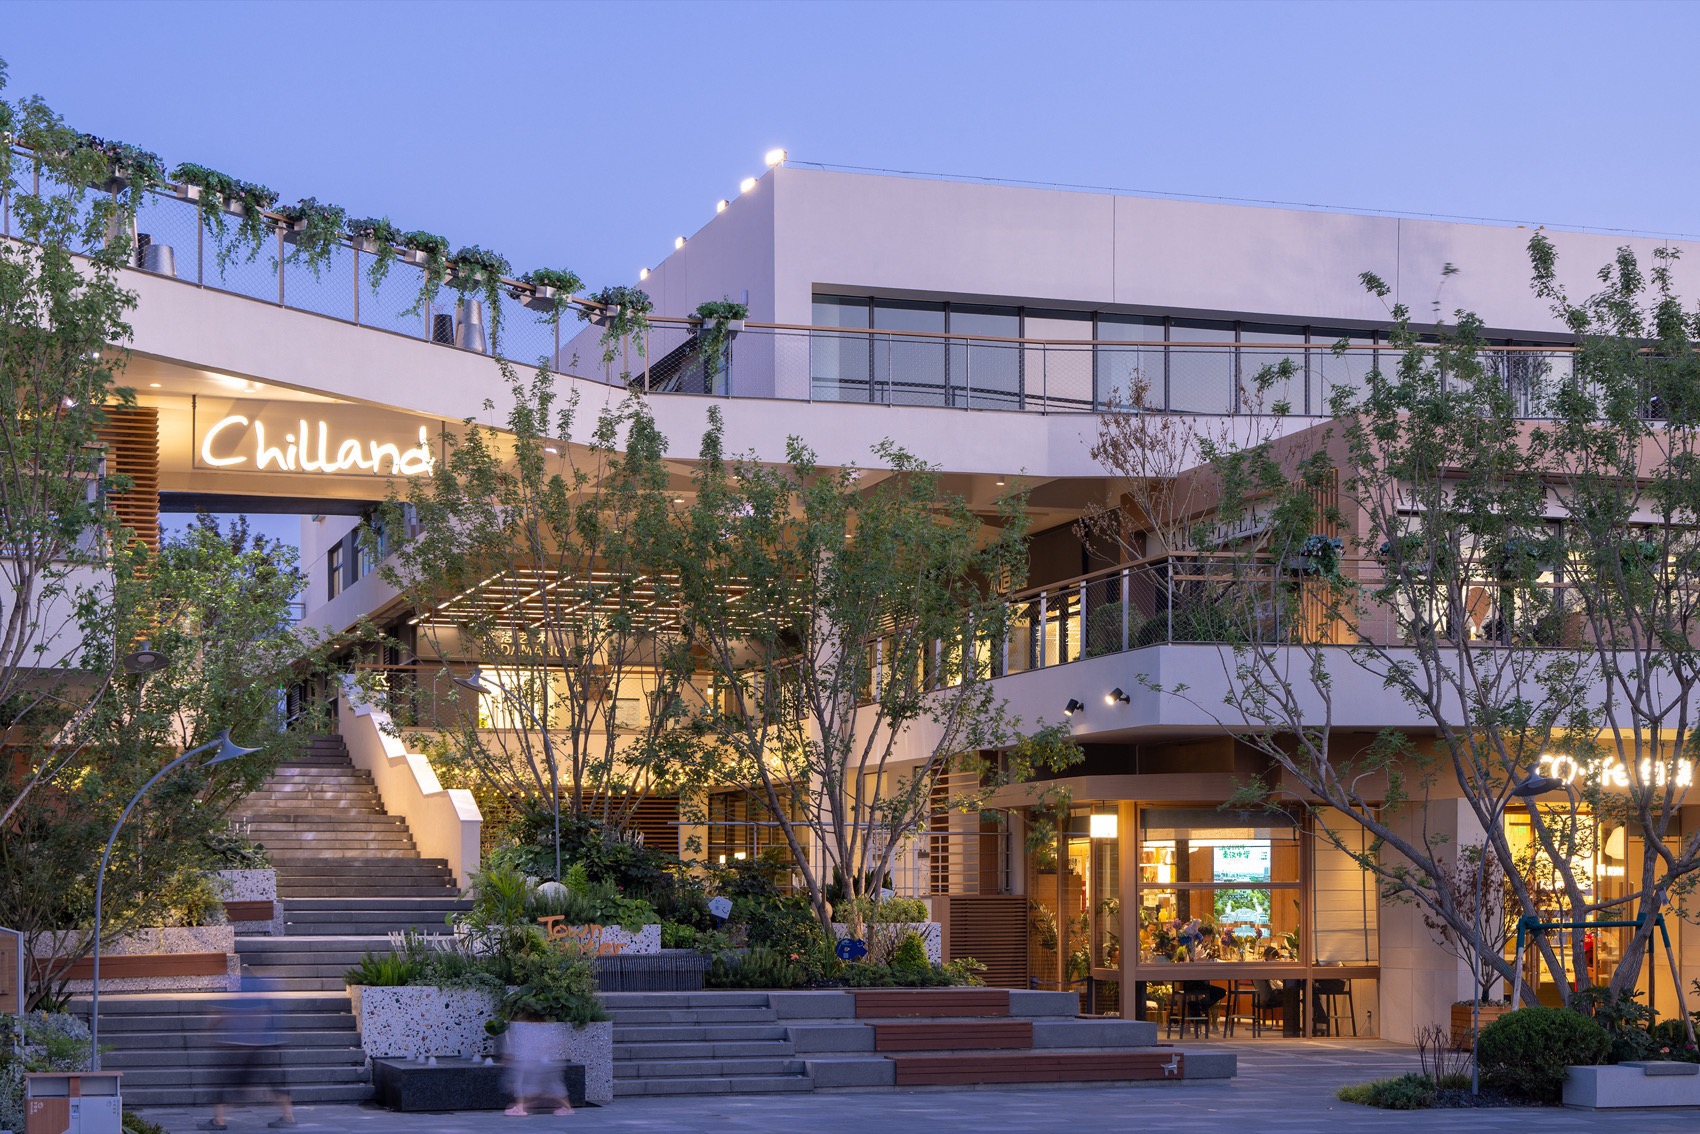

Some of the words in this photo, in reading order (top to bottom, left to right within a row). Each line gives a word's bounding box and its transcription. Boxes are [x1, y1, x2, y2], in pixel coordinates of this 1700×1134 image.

[202, 415, 434, 477] Chilland
[483, 643, 572, 657] DAMANCY
[537, 915, 603, 943] Town
